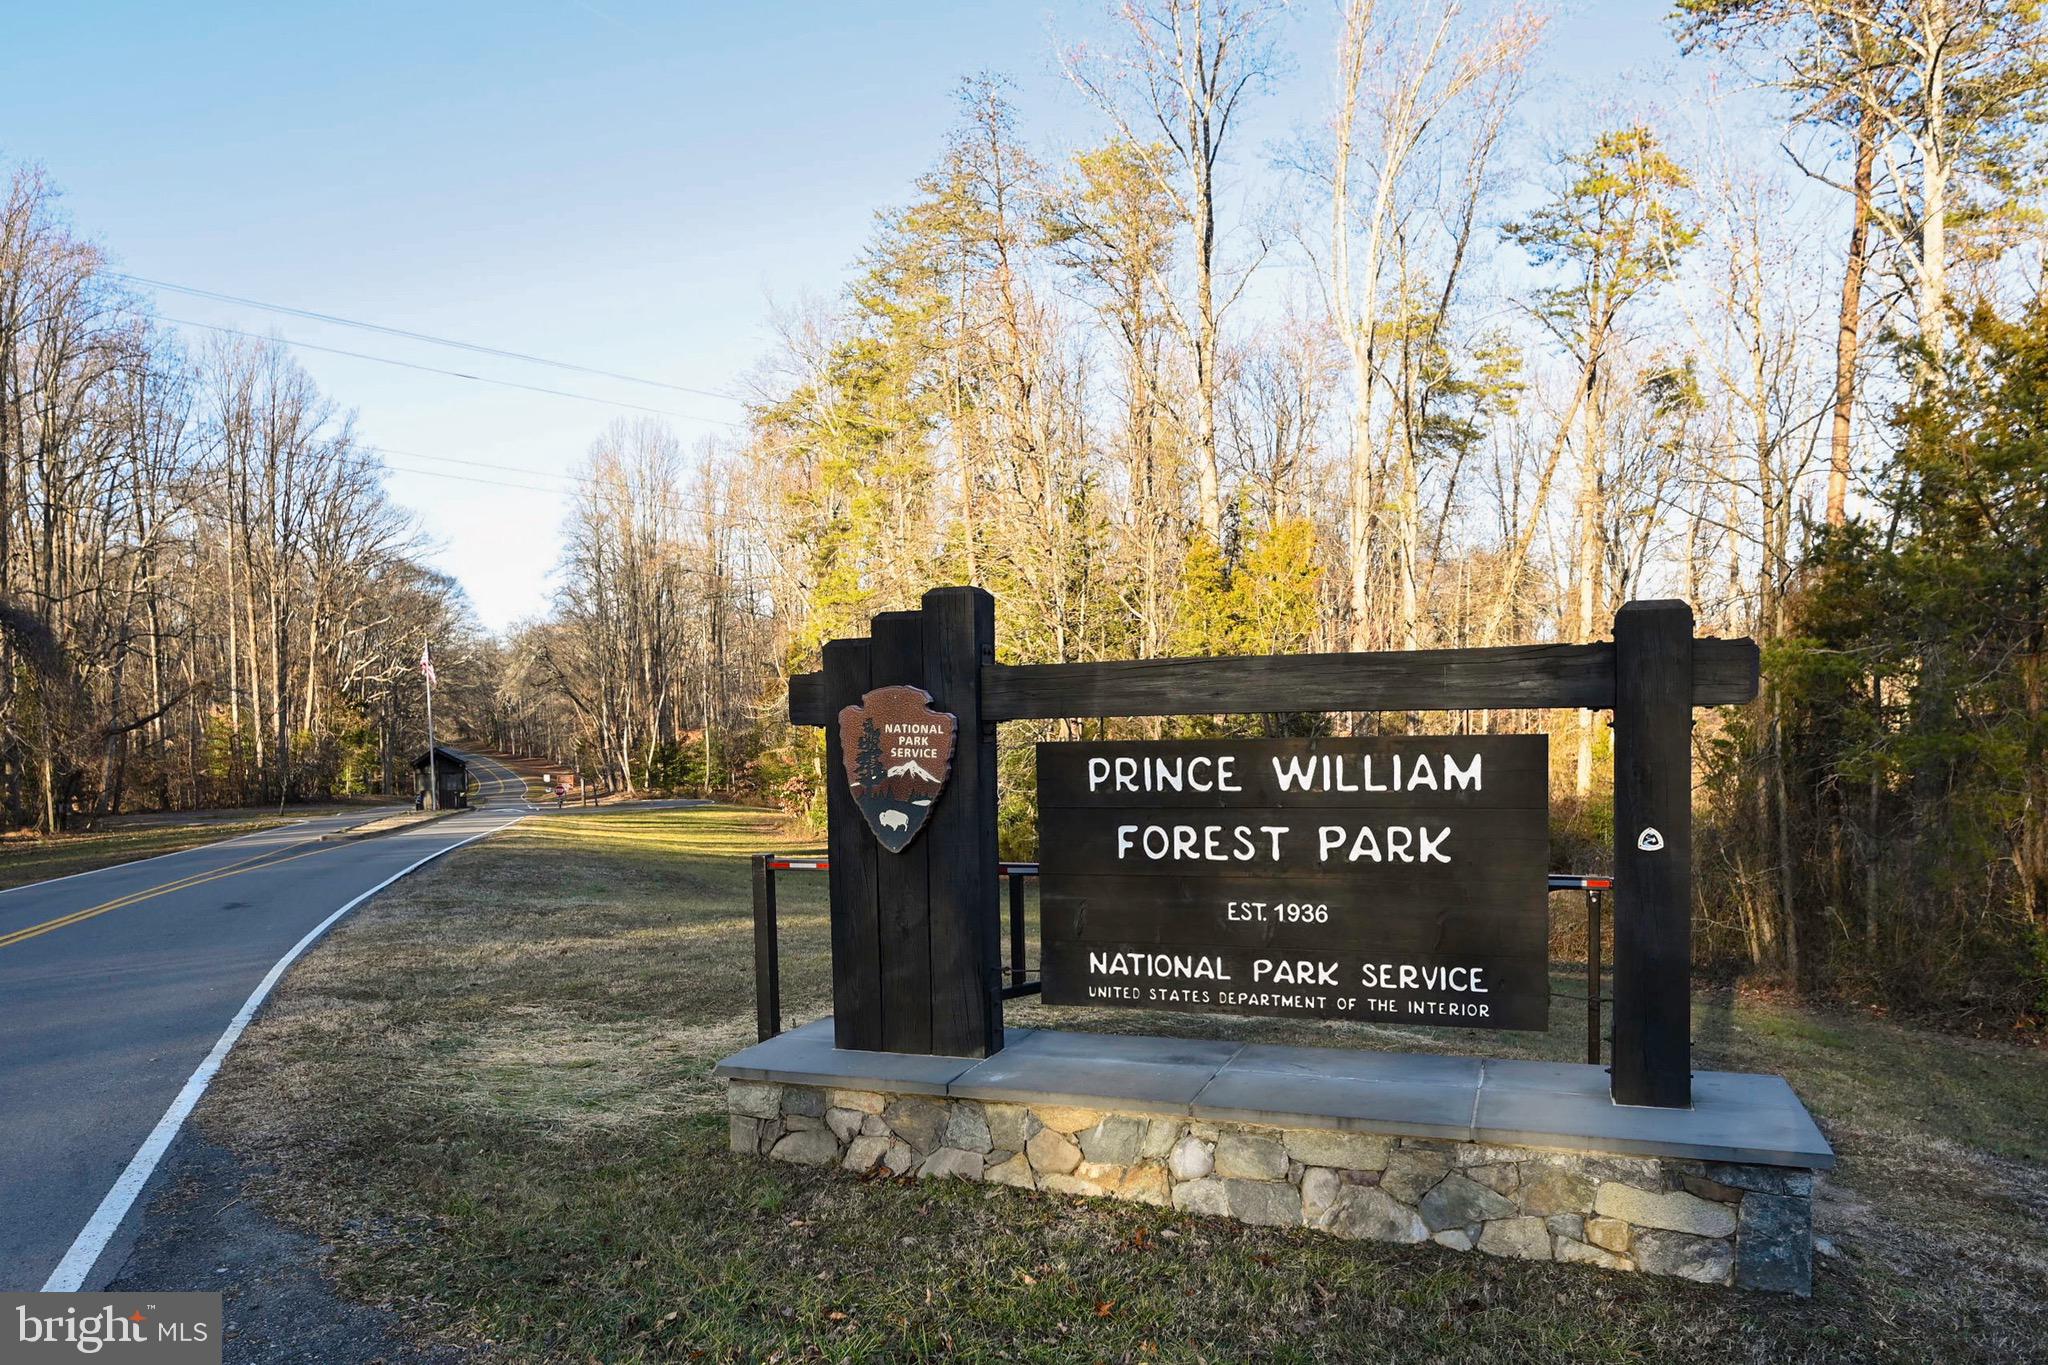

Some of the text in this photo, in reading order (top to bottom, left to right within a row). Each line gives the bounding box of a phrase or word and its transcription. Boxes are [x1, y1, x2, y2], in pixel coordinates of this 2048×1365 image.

[885, 723, 944, 734] NATIONAL
[898, 736, 929, 746] PARK
[890, 747, 938, 758] SERVICE
[1088, 753, 1482, 792] PRINCE WILLIAM
[1118, 825, 1451, 863] FOREST PARK
[1227, 902, 1328, 923] EST. 1936
[1089, 951, 1488, 993] NATIONAL PARK SERVICE
[1088, 986, 1490, 1018] UNITED STATES DEPARTMENT OF THE INTERIOR
